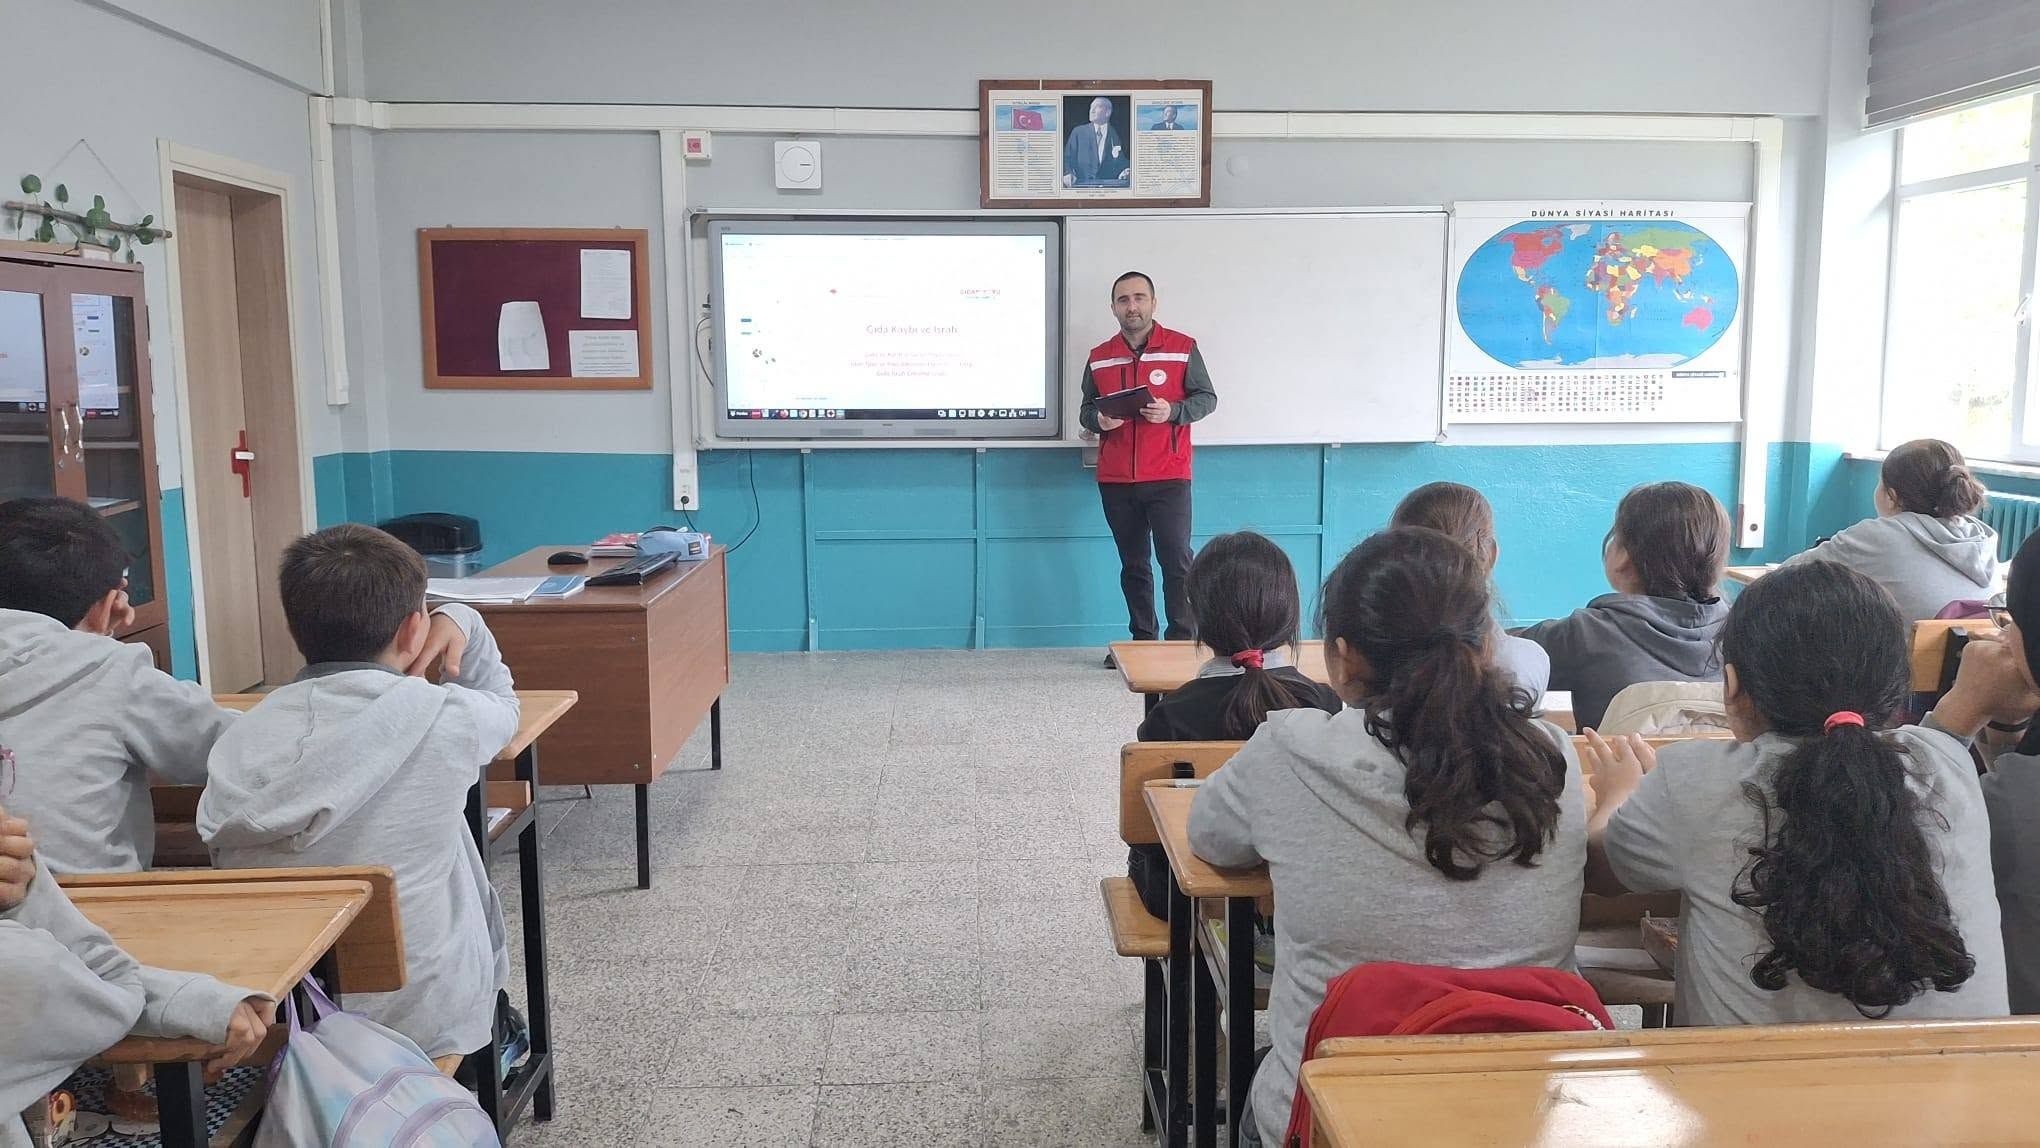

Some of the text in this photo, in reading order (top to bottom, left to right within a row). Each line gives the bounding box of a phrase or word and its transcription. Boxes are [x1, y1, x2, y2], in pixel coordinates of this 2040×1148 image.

[1531, 208, 1675, 217] DÜNYA SİYASİ HARİTASI
